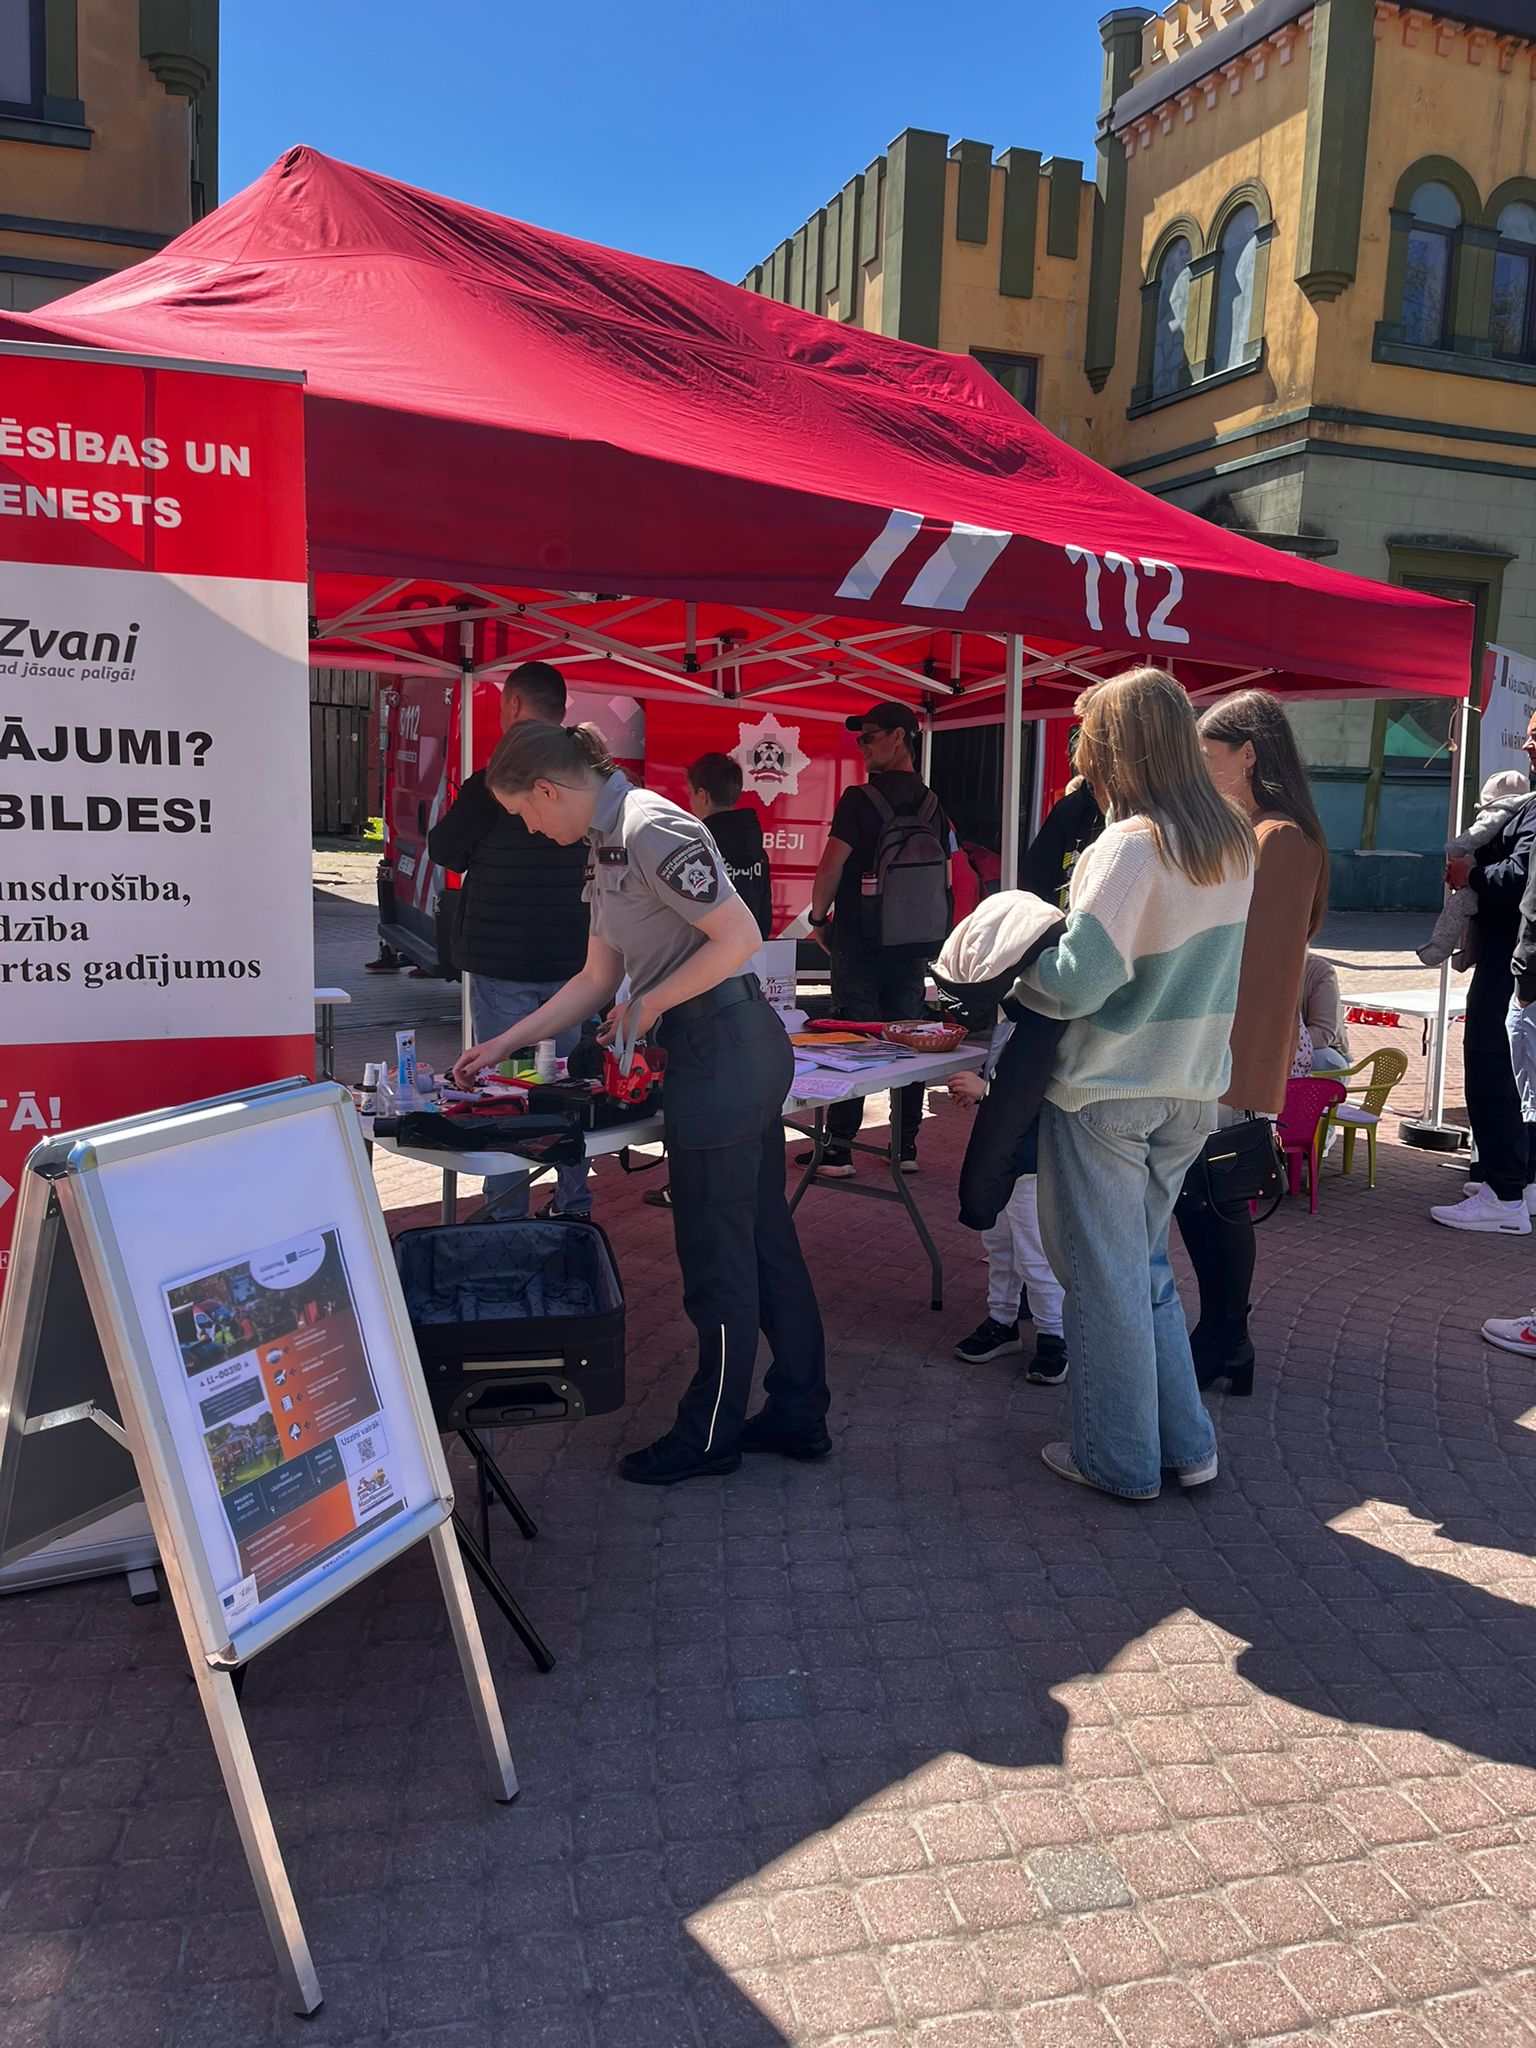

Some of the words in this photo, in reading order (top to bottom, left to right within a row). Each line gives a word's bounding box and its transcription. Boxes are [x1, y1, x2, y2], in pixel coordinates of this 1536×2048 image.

[0, 417, 169, 470] ĒSĪBAS
[185, 441, 250, 477] UN
[0, 483, 182, 529] ENESTS
[1065, 543, 1190, 644] 112
[0, 618, 141, 663] Zvani
[20, 662, 76, 678] jāsauc
[81, 666, 136, 683] palīgā!
[0, 716, 213, 767] ĀJUMI?
[405, 705, 420, 741] 112
[0, 794, 212, 834] BILDES!
[762, 829, 804, 850] BĒJI
[0, 915, 89, 942] dzība
[1, 957, 71, 983] rtas
[83, 953, 262, 989] gadījumos
[769, 985, 782, 994] 112
